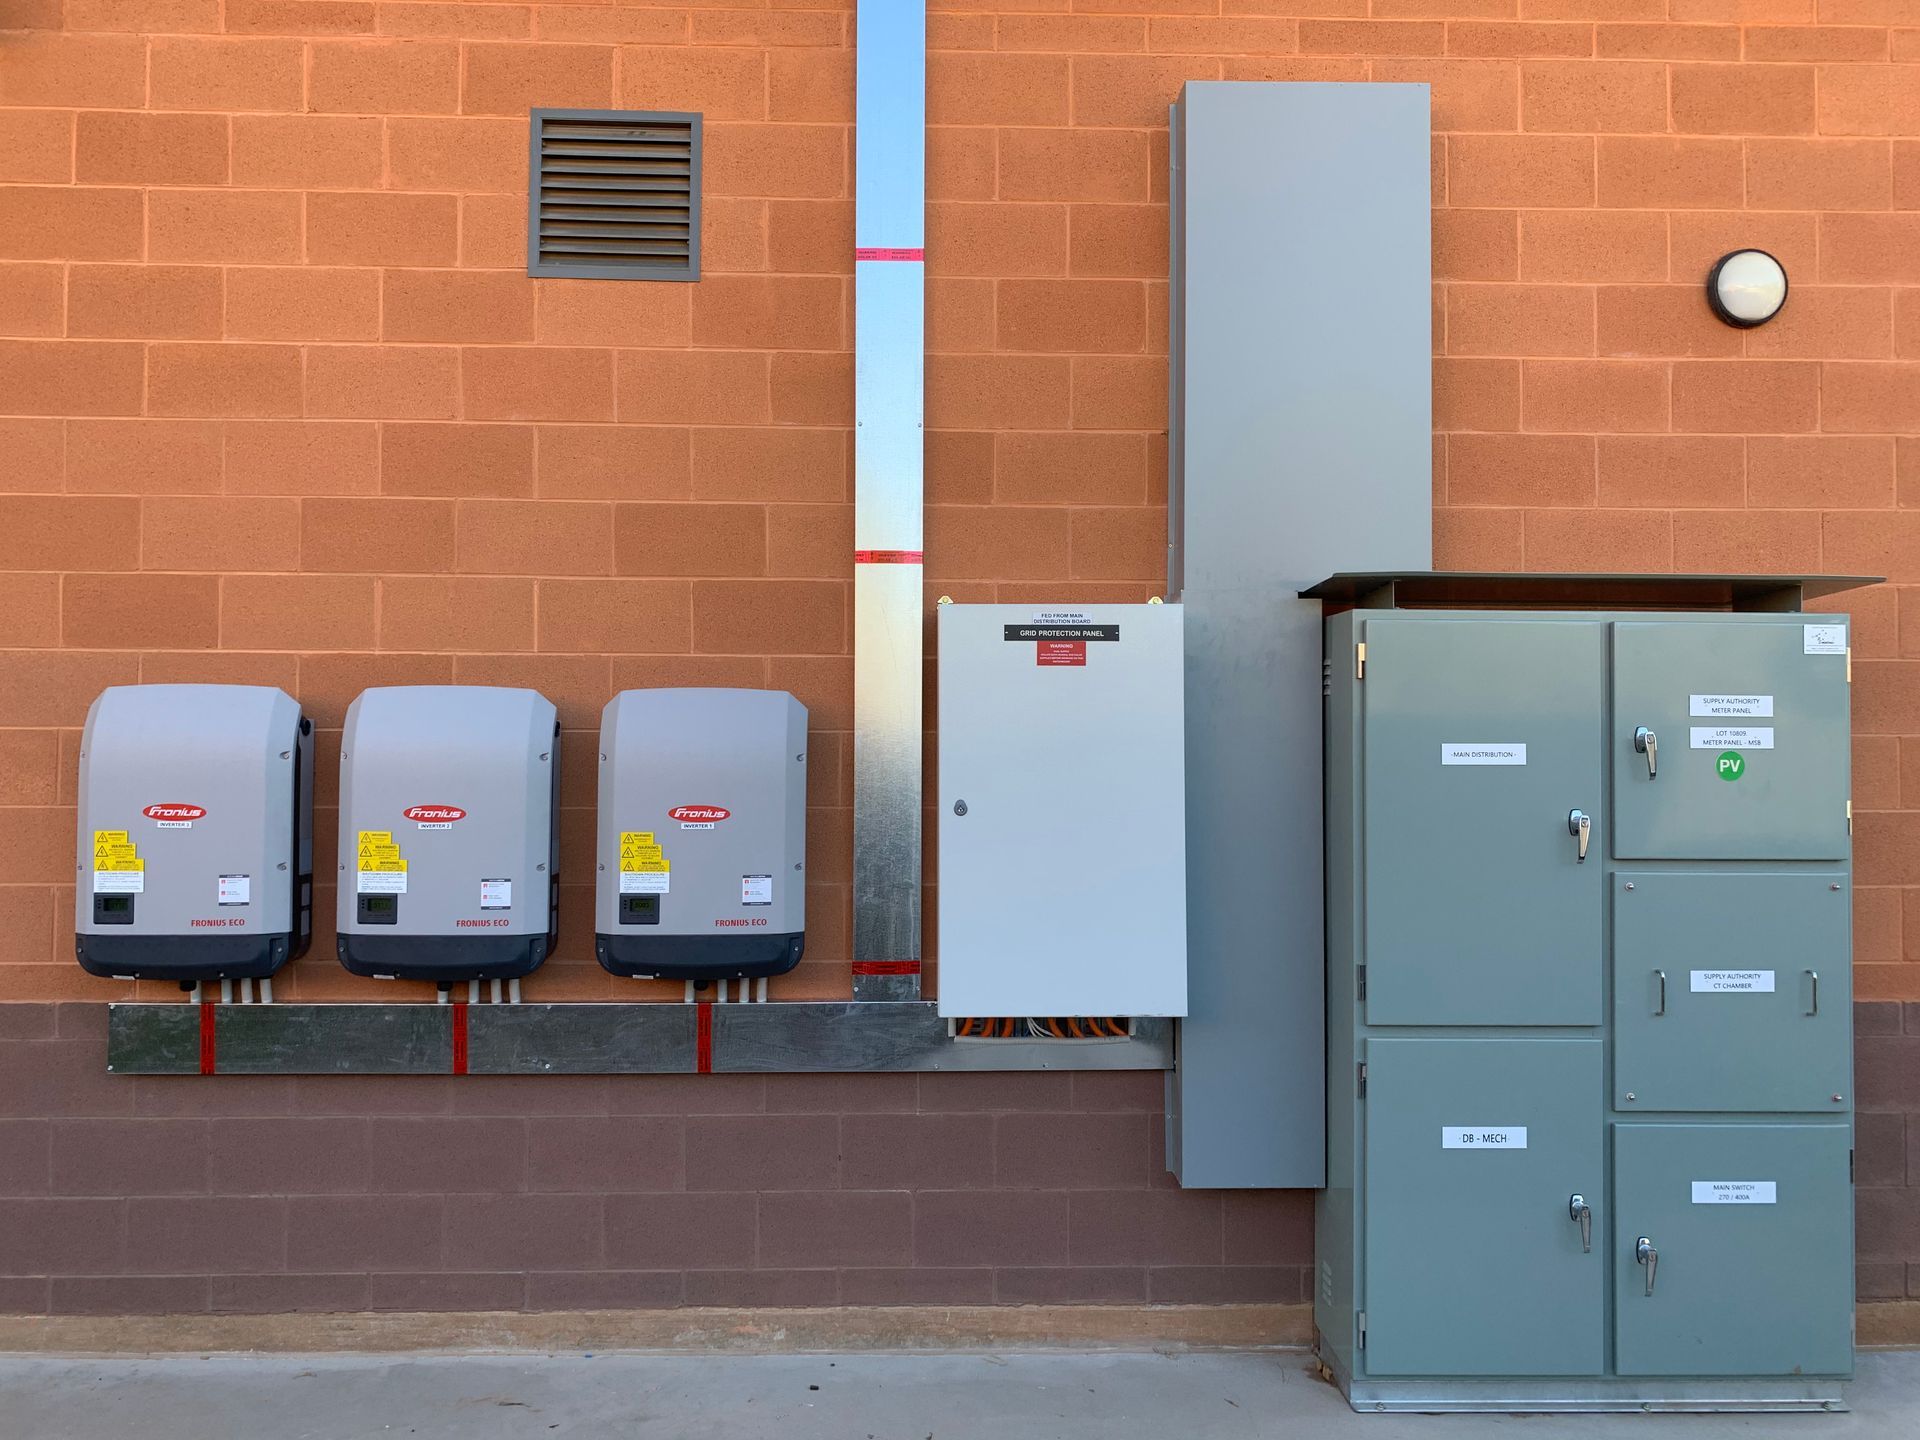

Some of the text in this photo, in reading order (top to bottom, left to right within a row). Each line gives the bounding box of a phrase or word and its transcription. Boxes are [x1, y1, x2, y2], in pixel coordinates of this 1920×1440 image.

[1720, 760, 1740, 772] PV
[148, 806, 202, 816] Fronius
[409, 808, 461, 818] Fronius
[674, 808, 726, 818] Fronius
[1462, 1134, 1474, 1143] DB
[1482, 1134, 1507, 1143] MECH
